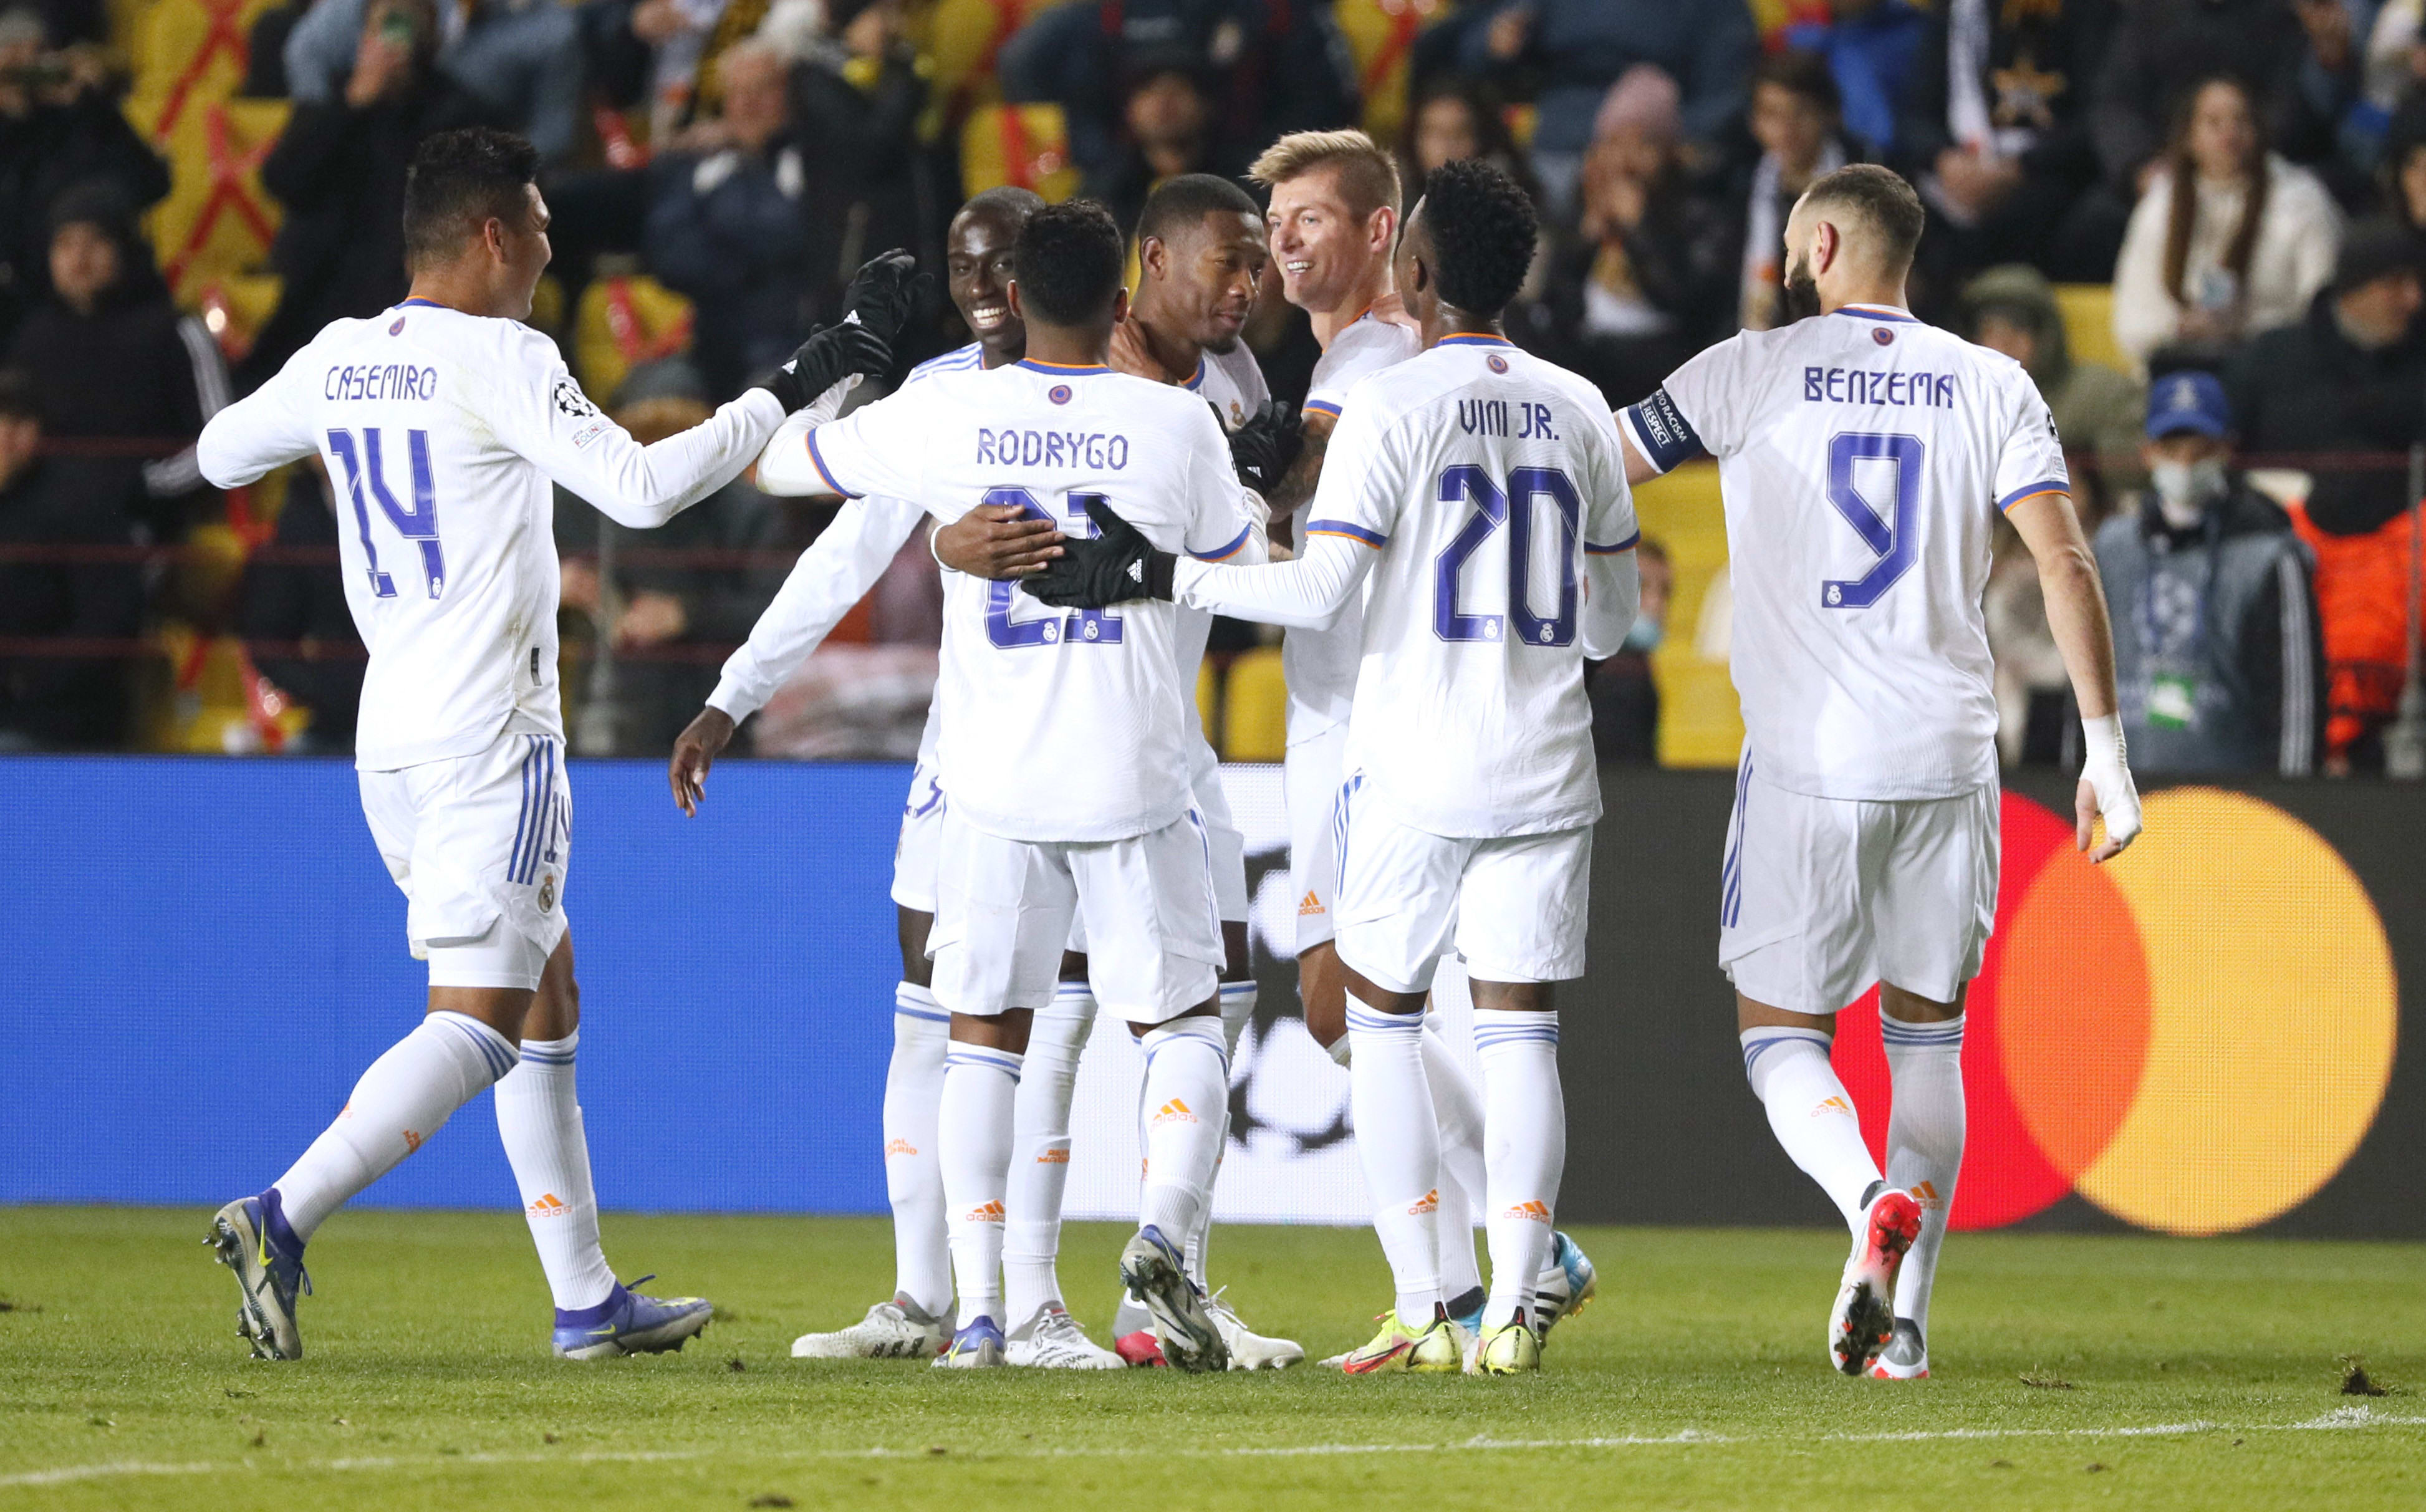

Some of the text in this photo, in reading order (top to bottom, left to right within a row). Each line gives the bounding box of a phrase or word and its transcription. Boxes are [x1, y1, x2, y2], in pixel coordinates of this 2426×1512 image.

[325, 365, 438, 401] CASEMIRO
[1804, 367, 1954, 409] BENZEMA
[1458, 399, 1559, 440] VINI JR.
[1644, 405, 1671, 445] RESPECT
[1662, 405, 1687, 442] RACISM
[976, 428, 1129, 471] RODRYGO
[327, 428, 446, 600] 14
[1821, 431, 1925, 609] 9
[1432, 464, 1581, 647] 20
[966, 1213, 1006, 1223] adida
